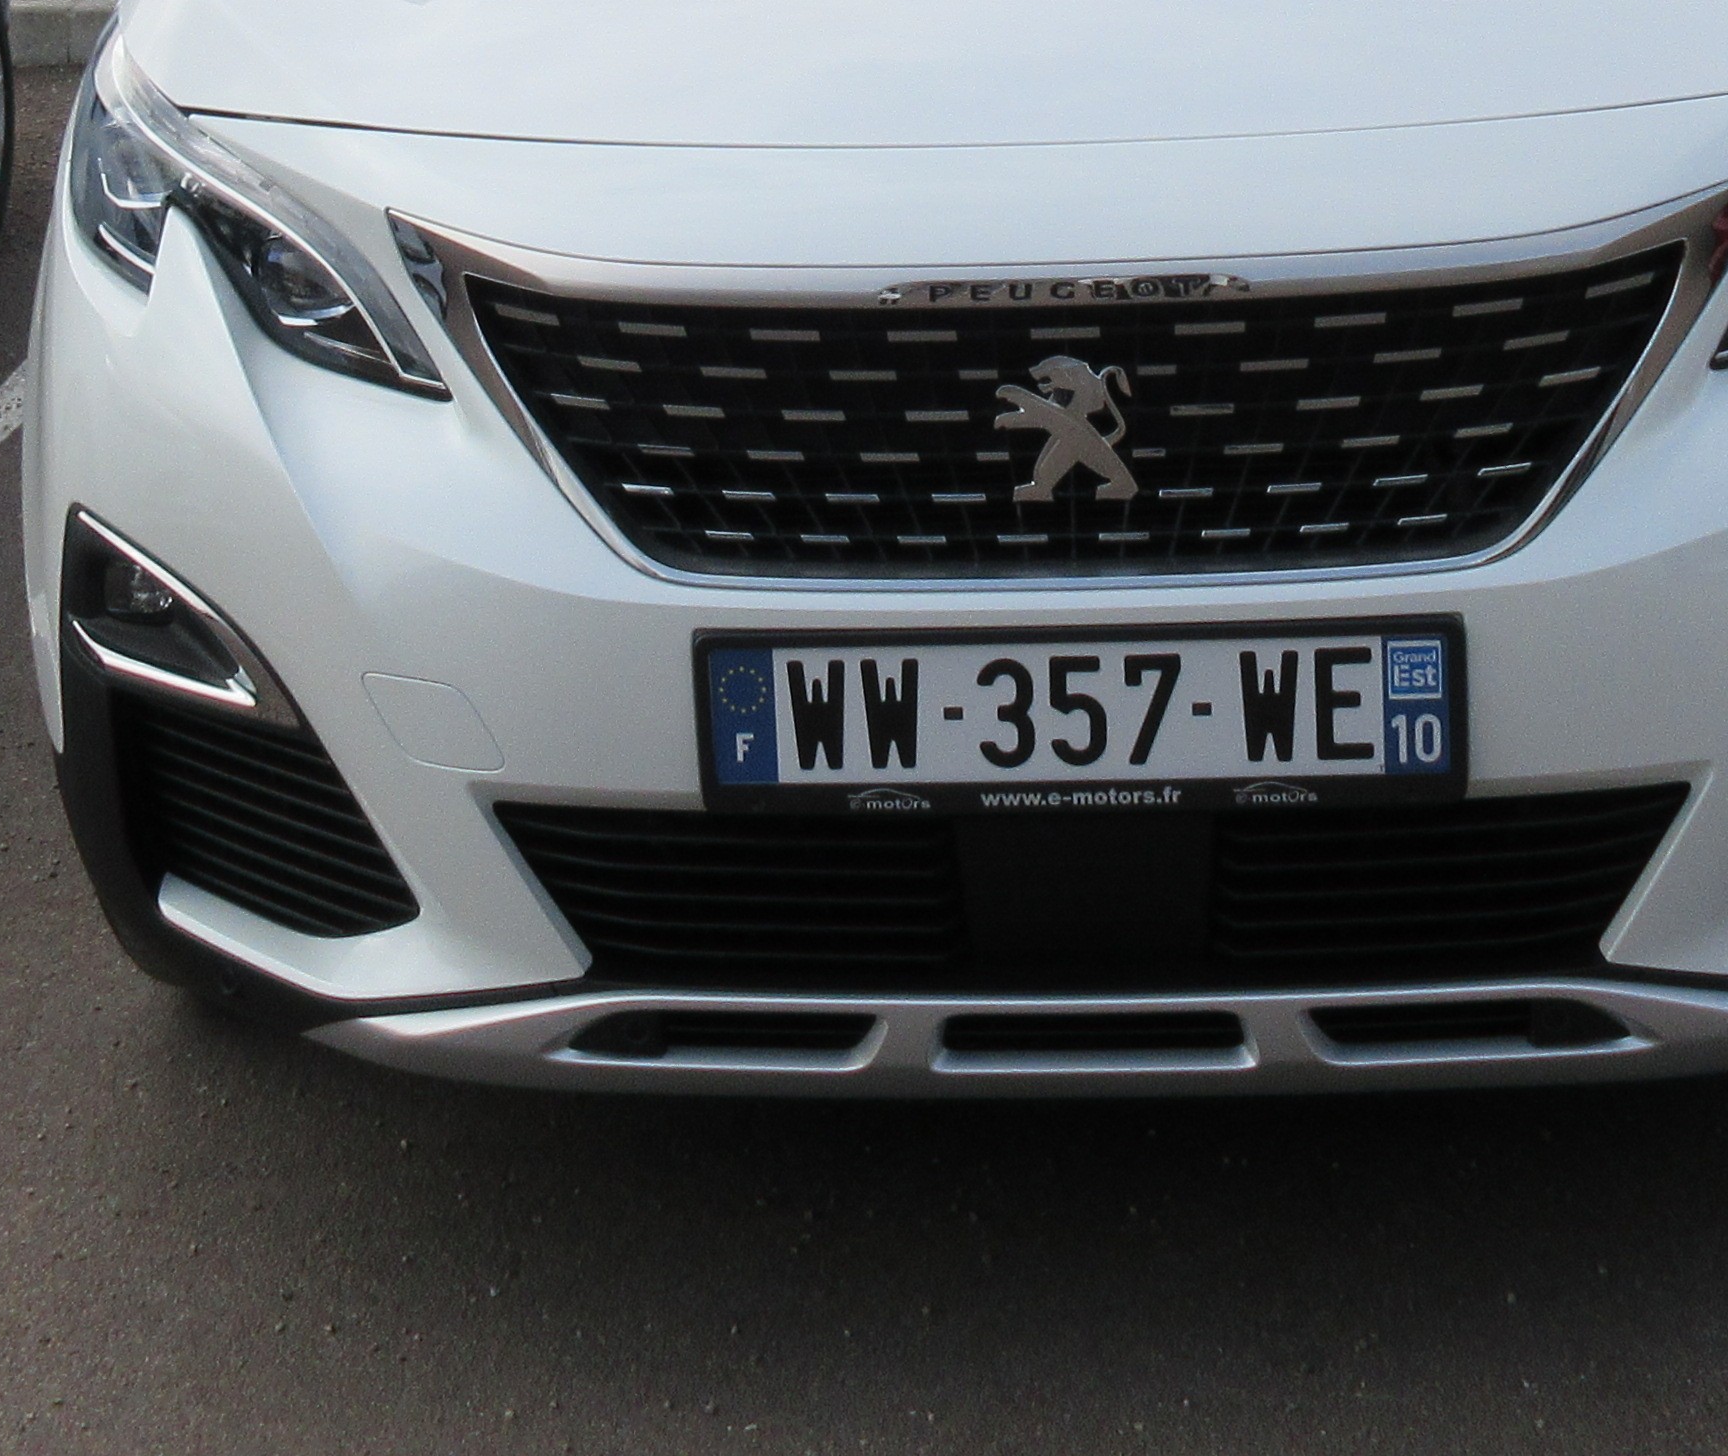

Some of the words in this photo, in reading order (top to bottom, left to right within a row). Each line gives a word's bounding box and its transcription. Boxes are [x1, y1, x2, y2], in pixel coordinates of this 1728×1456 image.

[927, 275, 1202, 304] PEUGEOT
[1392, 650, 1436, 663] Grand
[1393, 665, 1437, 687] Est
[786, 647, 1375, 770] WW-357-WE
[736, 733, 754, 762] F
[1391, 714, 1442, 763] 10
[980, 786, 1182, 808] www.e-motors.fr
